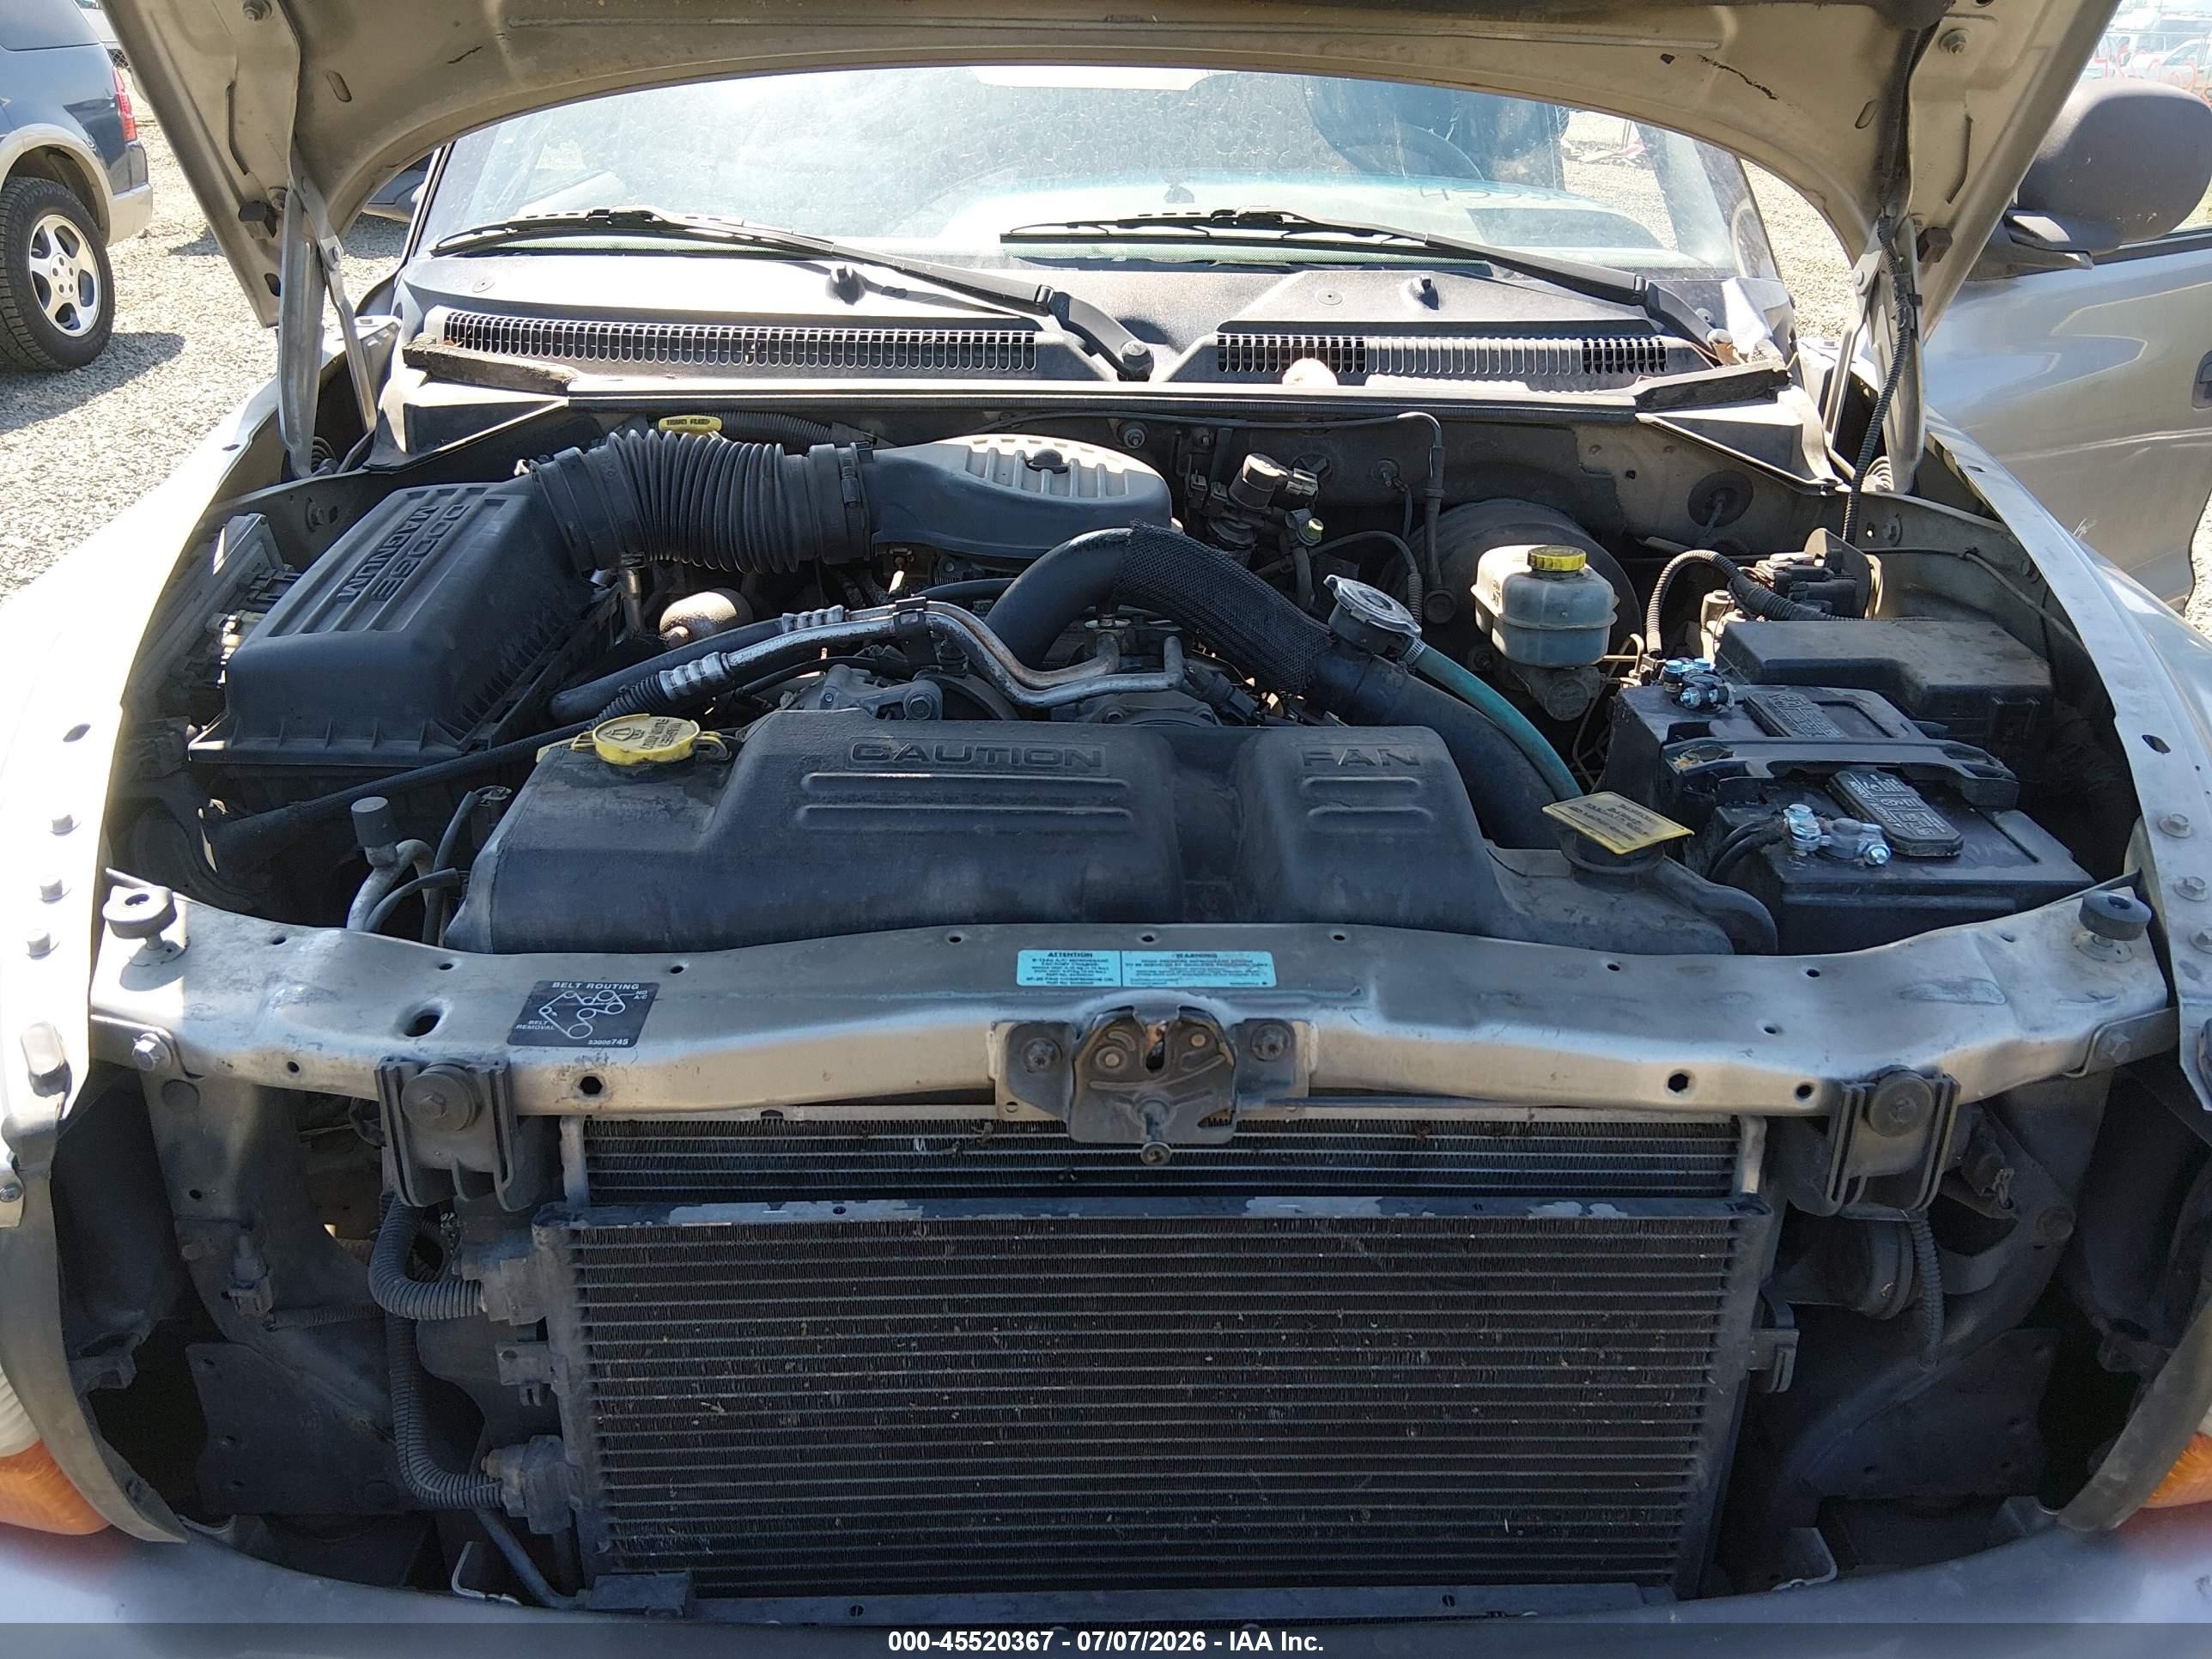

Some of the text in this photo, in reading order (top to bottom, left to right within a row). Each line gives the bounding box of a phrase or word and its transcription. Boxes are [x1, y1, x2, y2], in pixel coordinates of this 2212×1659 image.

[336, 505, 440, 603] MAGNUM
[371, 504, 471, 602] DODGE
[851, 742, 1103, 769] CAUTION
[1301, 749, 1421, 767] FAN
